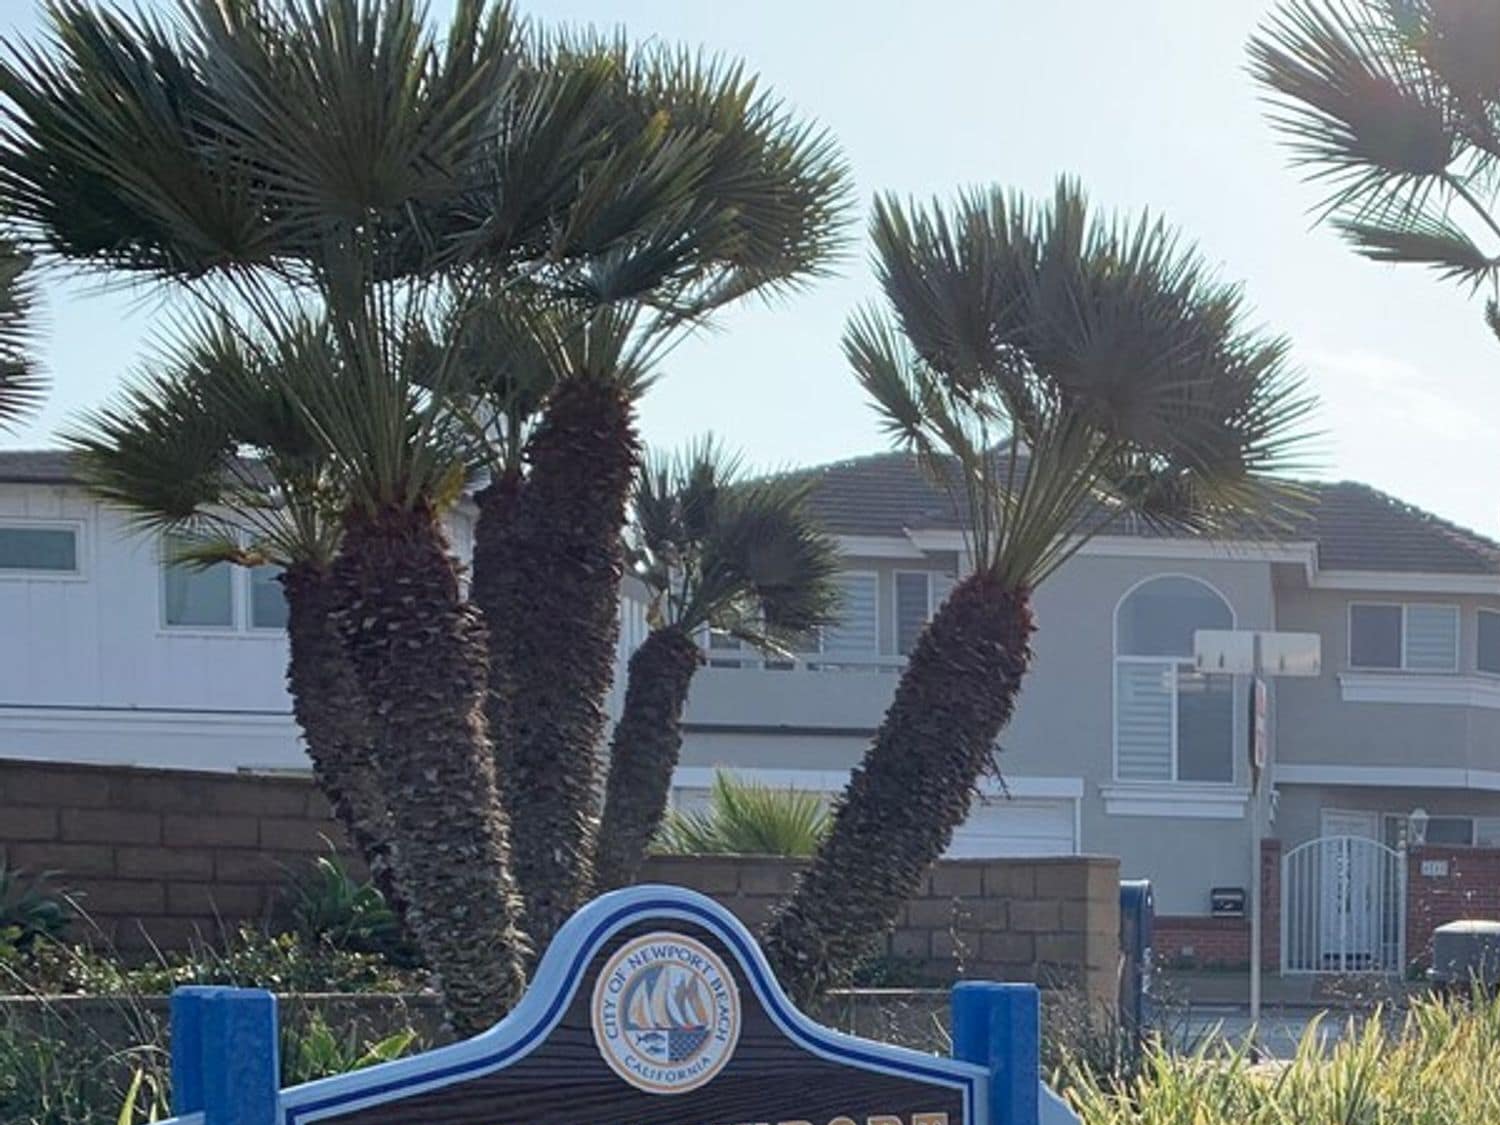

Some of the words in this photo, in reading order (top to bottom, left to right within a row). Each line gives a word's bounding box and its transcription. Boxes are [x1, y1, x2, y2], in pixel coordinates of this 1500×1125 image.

[627, 944, 714, 974] NEWPORT
[607, 967, 627, 995] OF
[603, 1000, 619, 1040] CITY
[710, 976, 730, 1042] BEACH
[624, 1055, 713, 1082] CALIFORNIA
